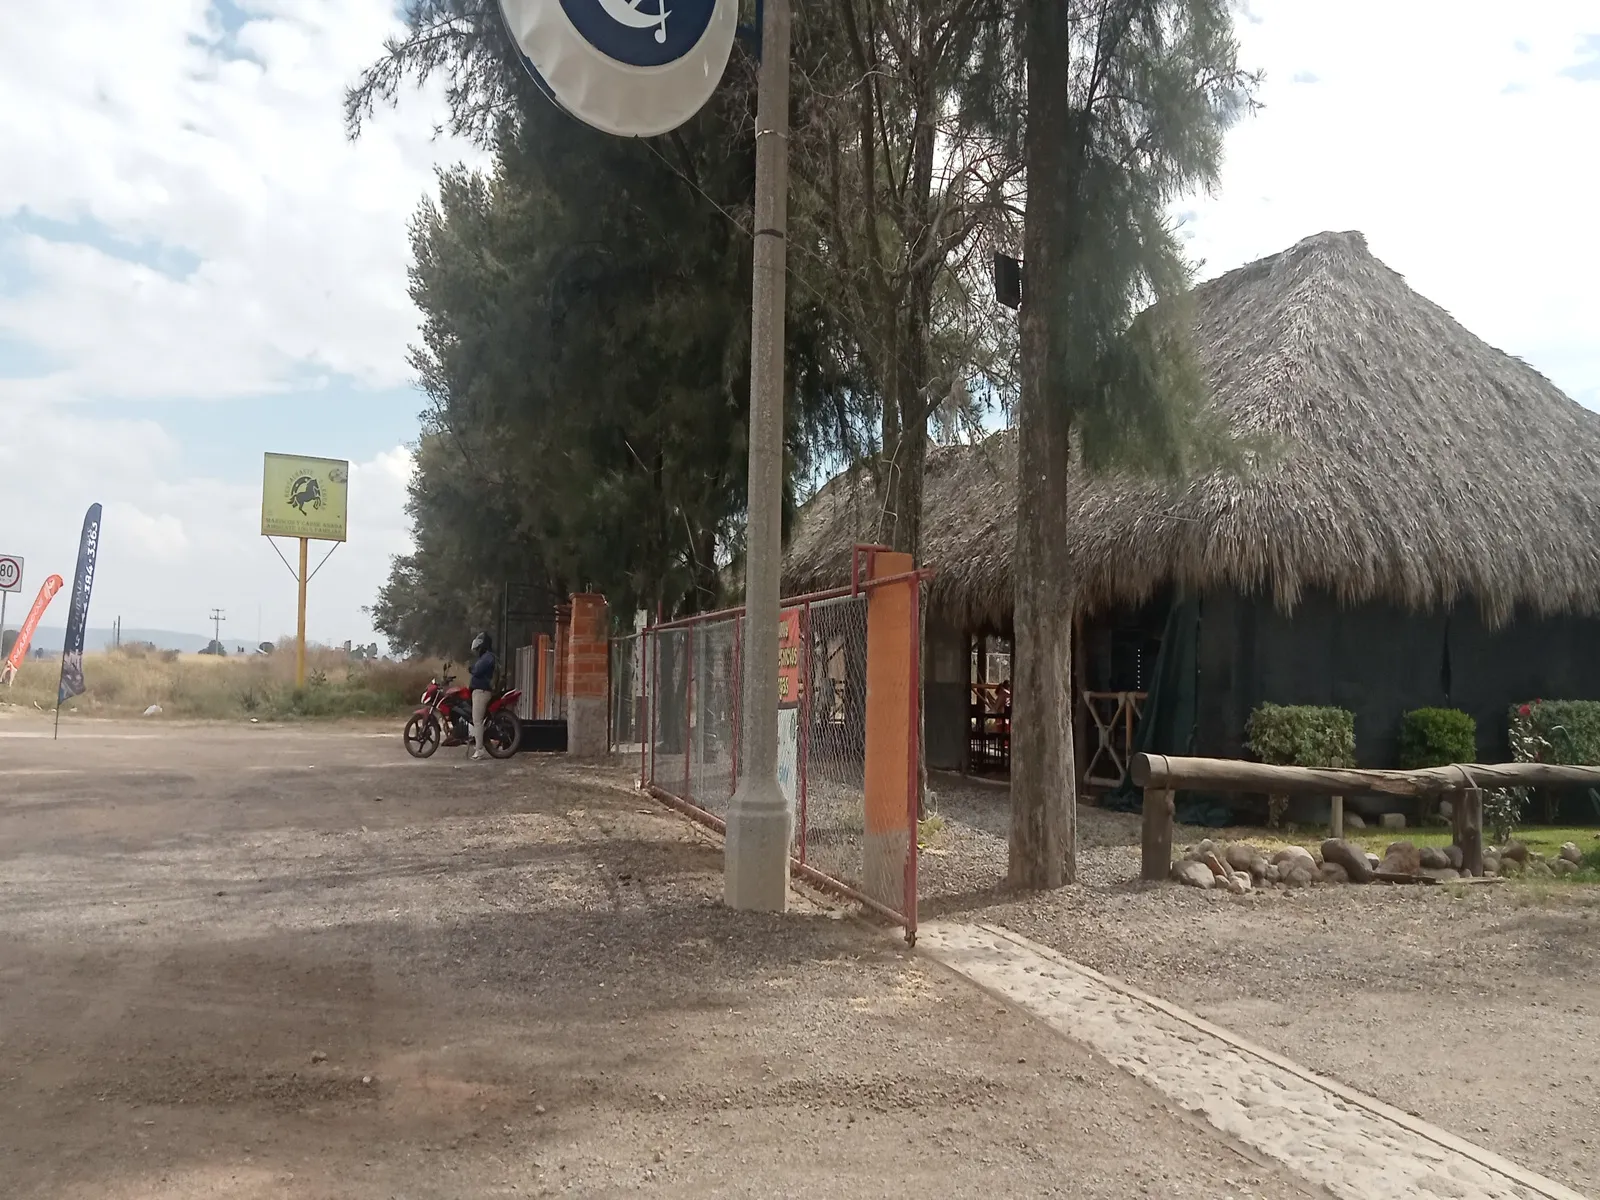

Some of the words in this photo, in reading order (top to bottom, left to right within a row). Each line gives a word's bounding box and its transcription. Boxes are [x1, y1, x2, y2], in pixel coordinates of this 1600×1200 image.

[265, 517, 295, 525] MARISCOS
[322, 522, 343, 530] ASADA
[0, 563, 14, 578] 80
